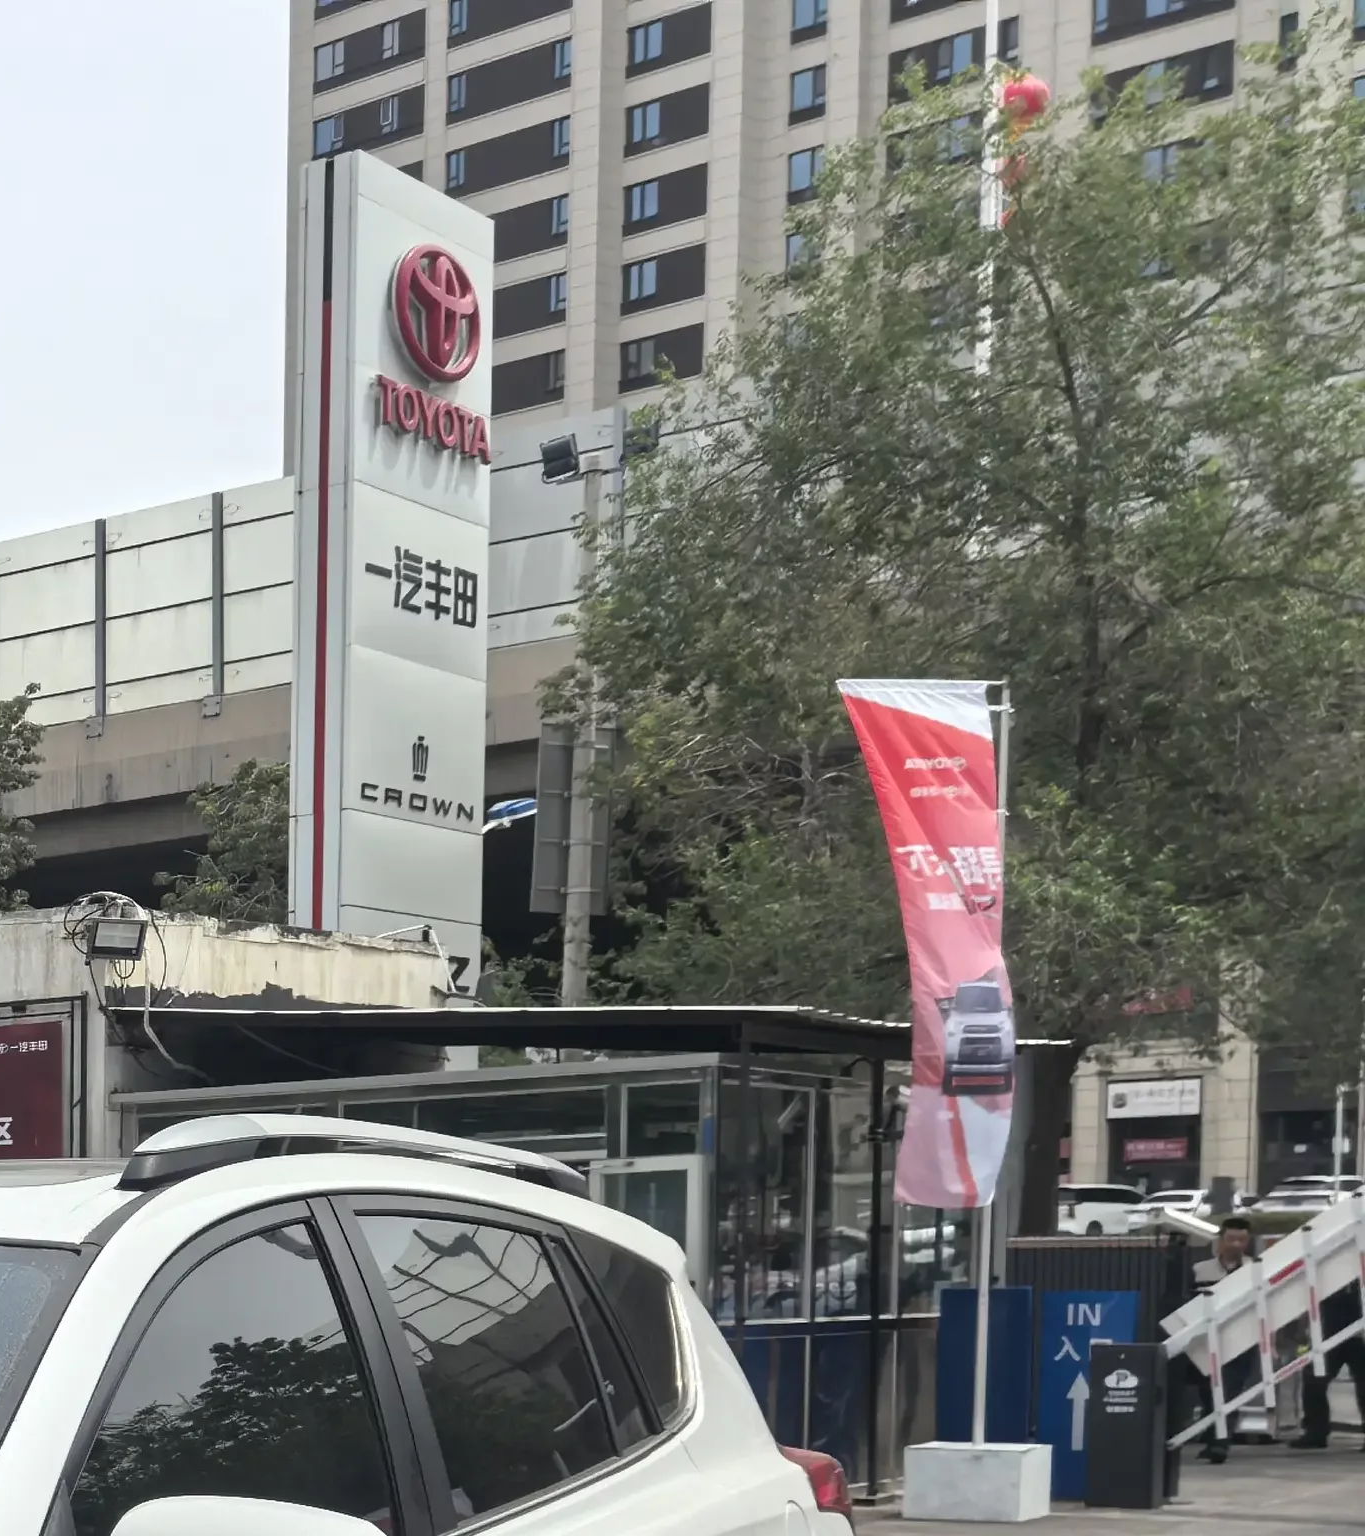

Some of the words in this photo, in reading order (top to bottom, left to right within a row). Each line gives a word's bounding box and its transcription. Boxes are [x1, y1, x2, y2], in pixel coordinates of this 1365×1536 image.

[376, 373, 491, 464] TOYOTA
[364, 544, 479, 628] 一汽丰田
[360, 781, 474, 824] CROWN
[10, 1039, 48, 1053] 一汽丰田
[1066, 1302, 1102, 1327] IN
